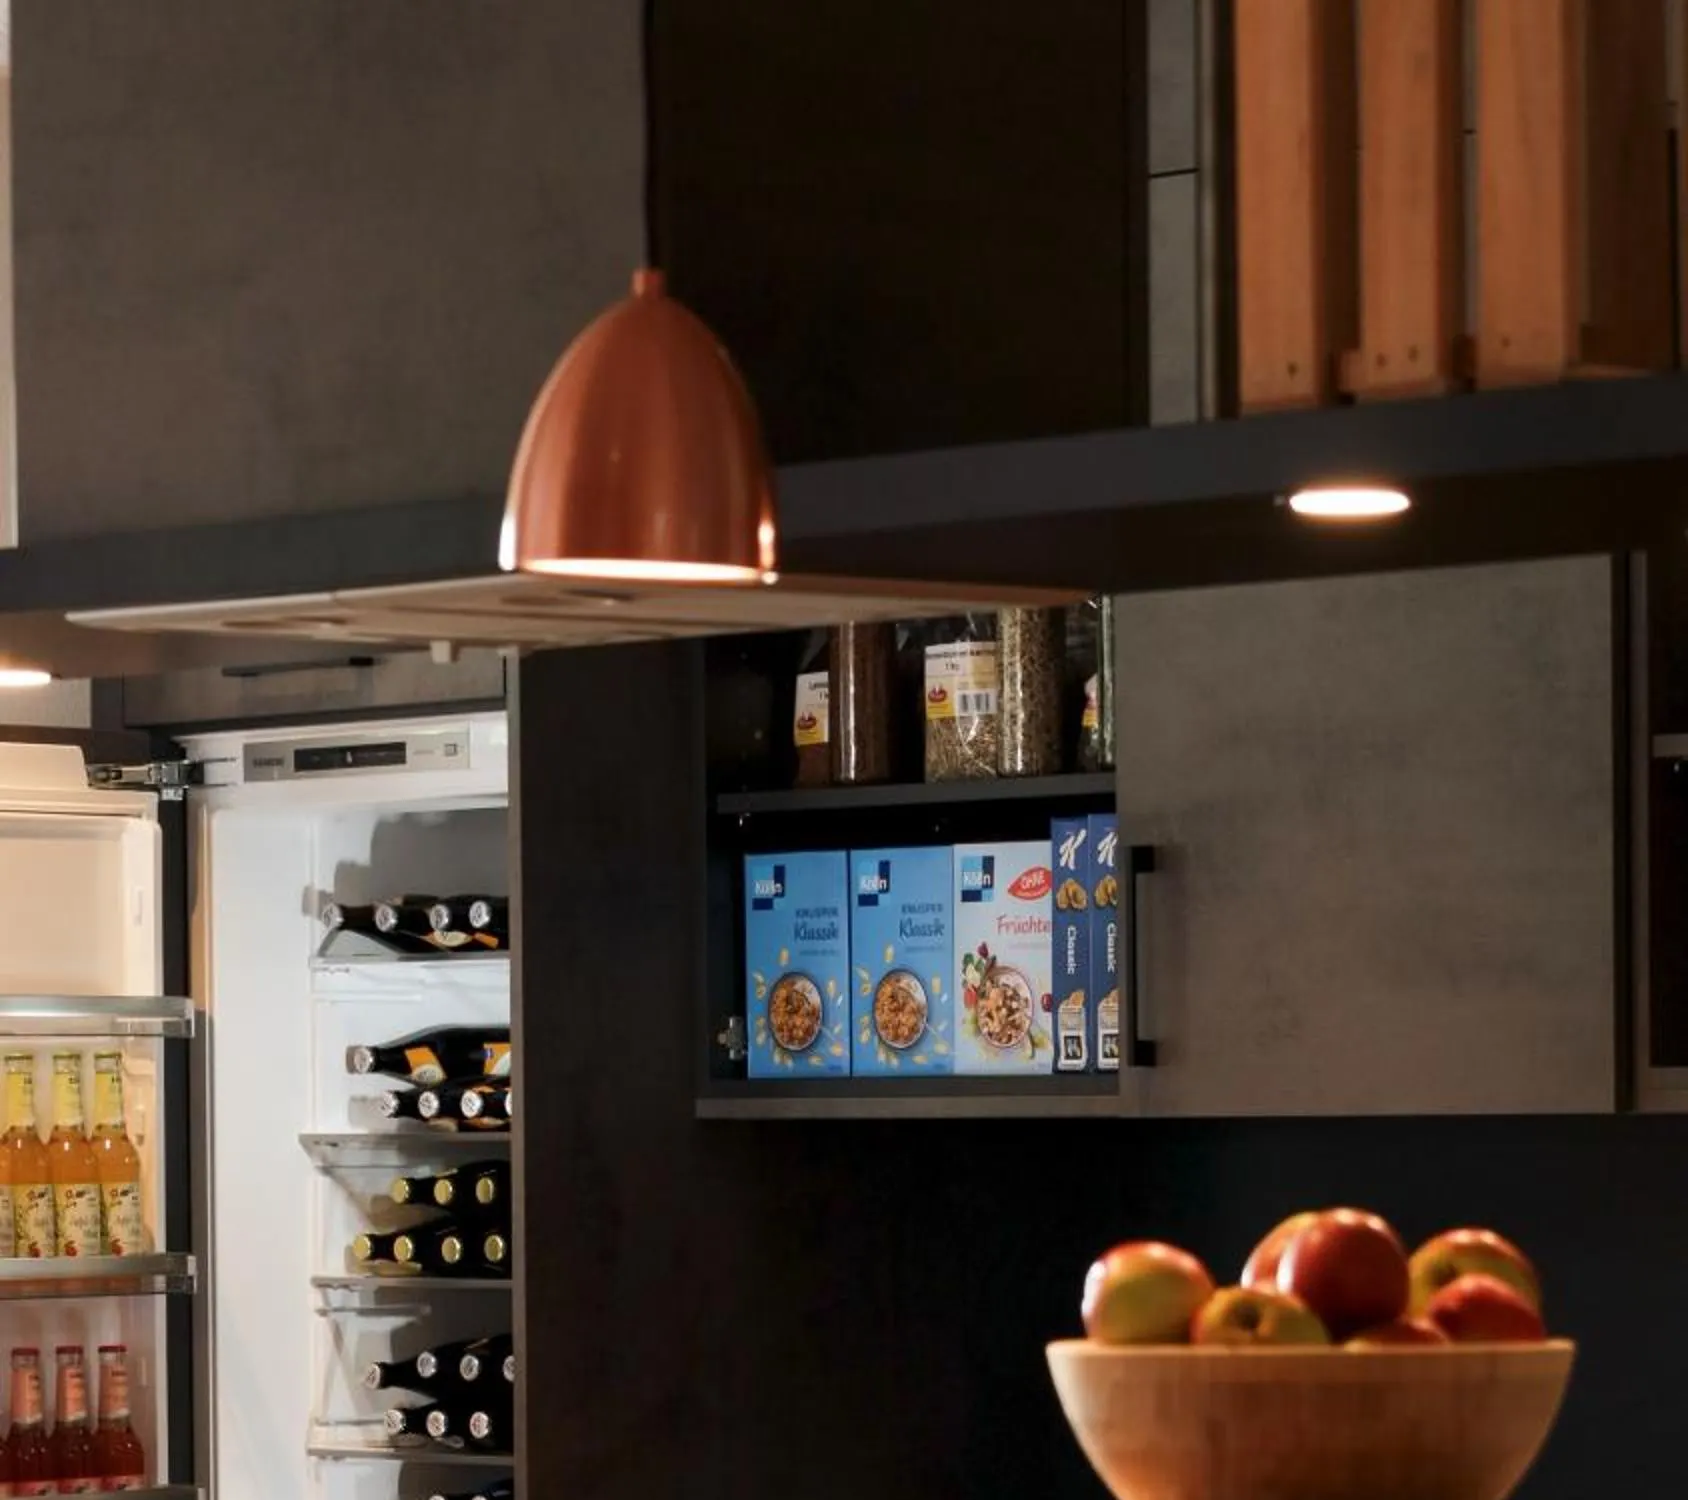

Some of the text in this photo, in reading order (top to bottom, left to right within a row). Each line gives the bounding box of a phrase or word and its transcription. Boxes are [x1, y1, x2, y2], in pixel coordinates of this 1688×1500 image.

[794, 921, 839, 942] Klassik
[899, 917, 945, 938] Klassik
[1067, 925, 1077, 975] Classic
